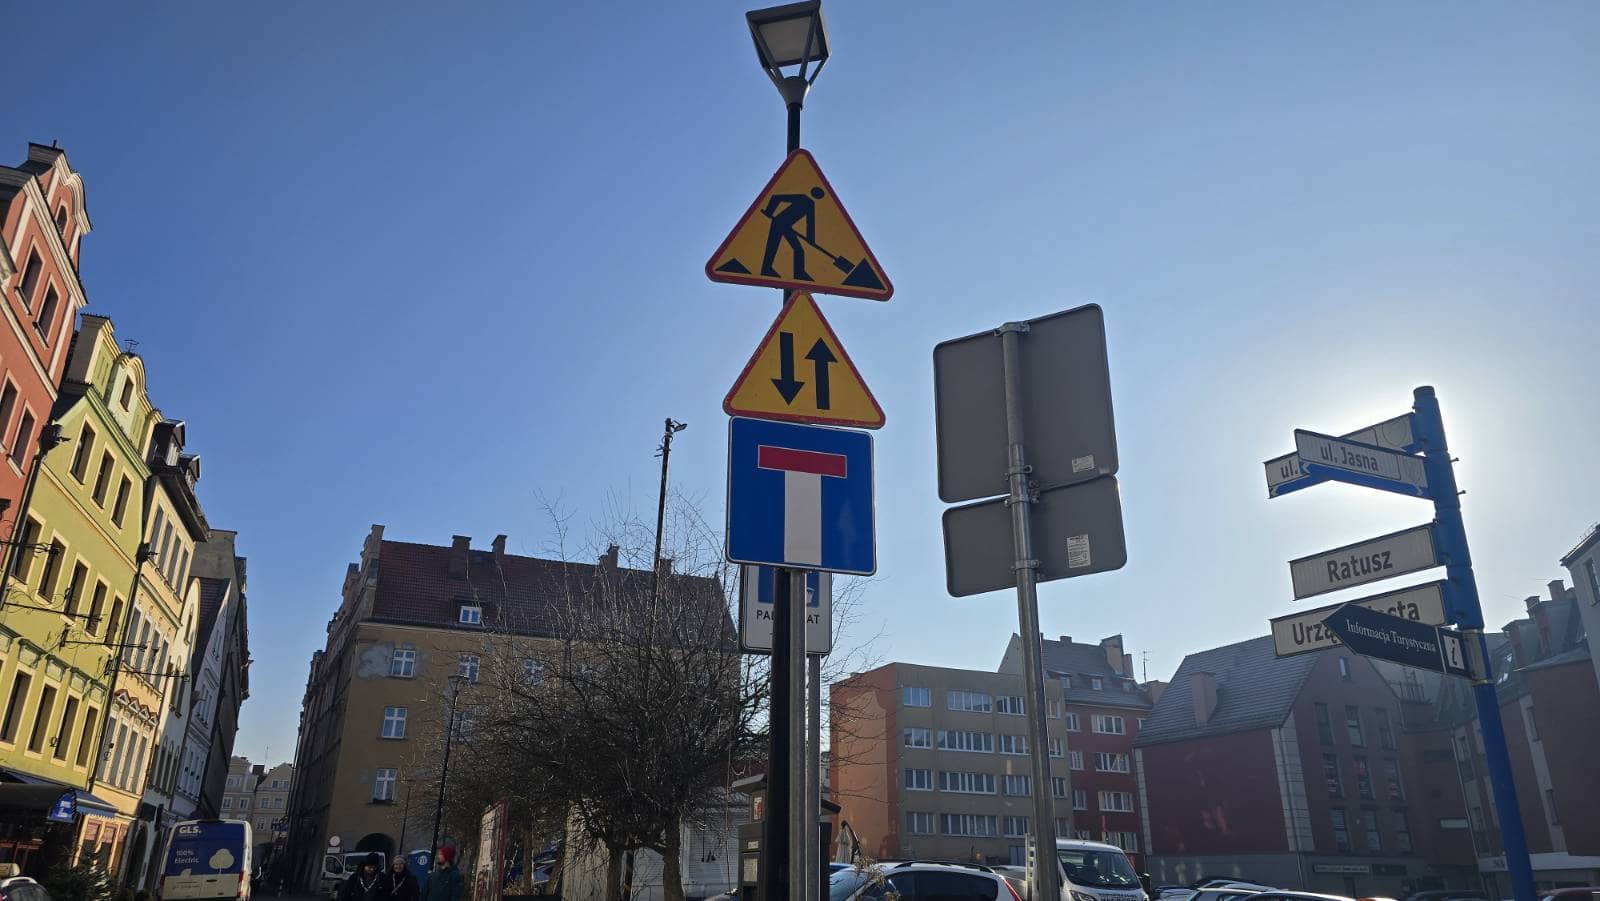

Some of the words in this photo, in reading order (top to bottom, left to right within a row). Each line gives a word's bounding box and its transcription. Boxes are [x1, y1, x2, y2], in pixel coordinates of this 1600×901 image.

[1280, 460, 1298, 478] ul.
[1320, 443, 1337, 463] ul.
[1341, 446, 1379, 471] Jasna
[1327, 551, 1392, 581] Ratusz
[1292, 622, 1338, 645] Urzą
[1346, 619, 1390, 643] Informacja
[1390, 630, 1436, 652] Turystyczna
